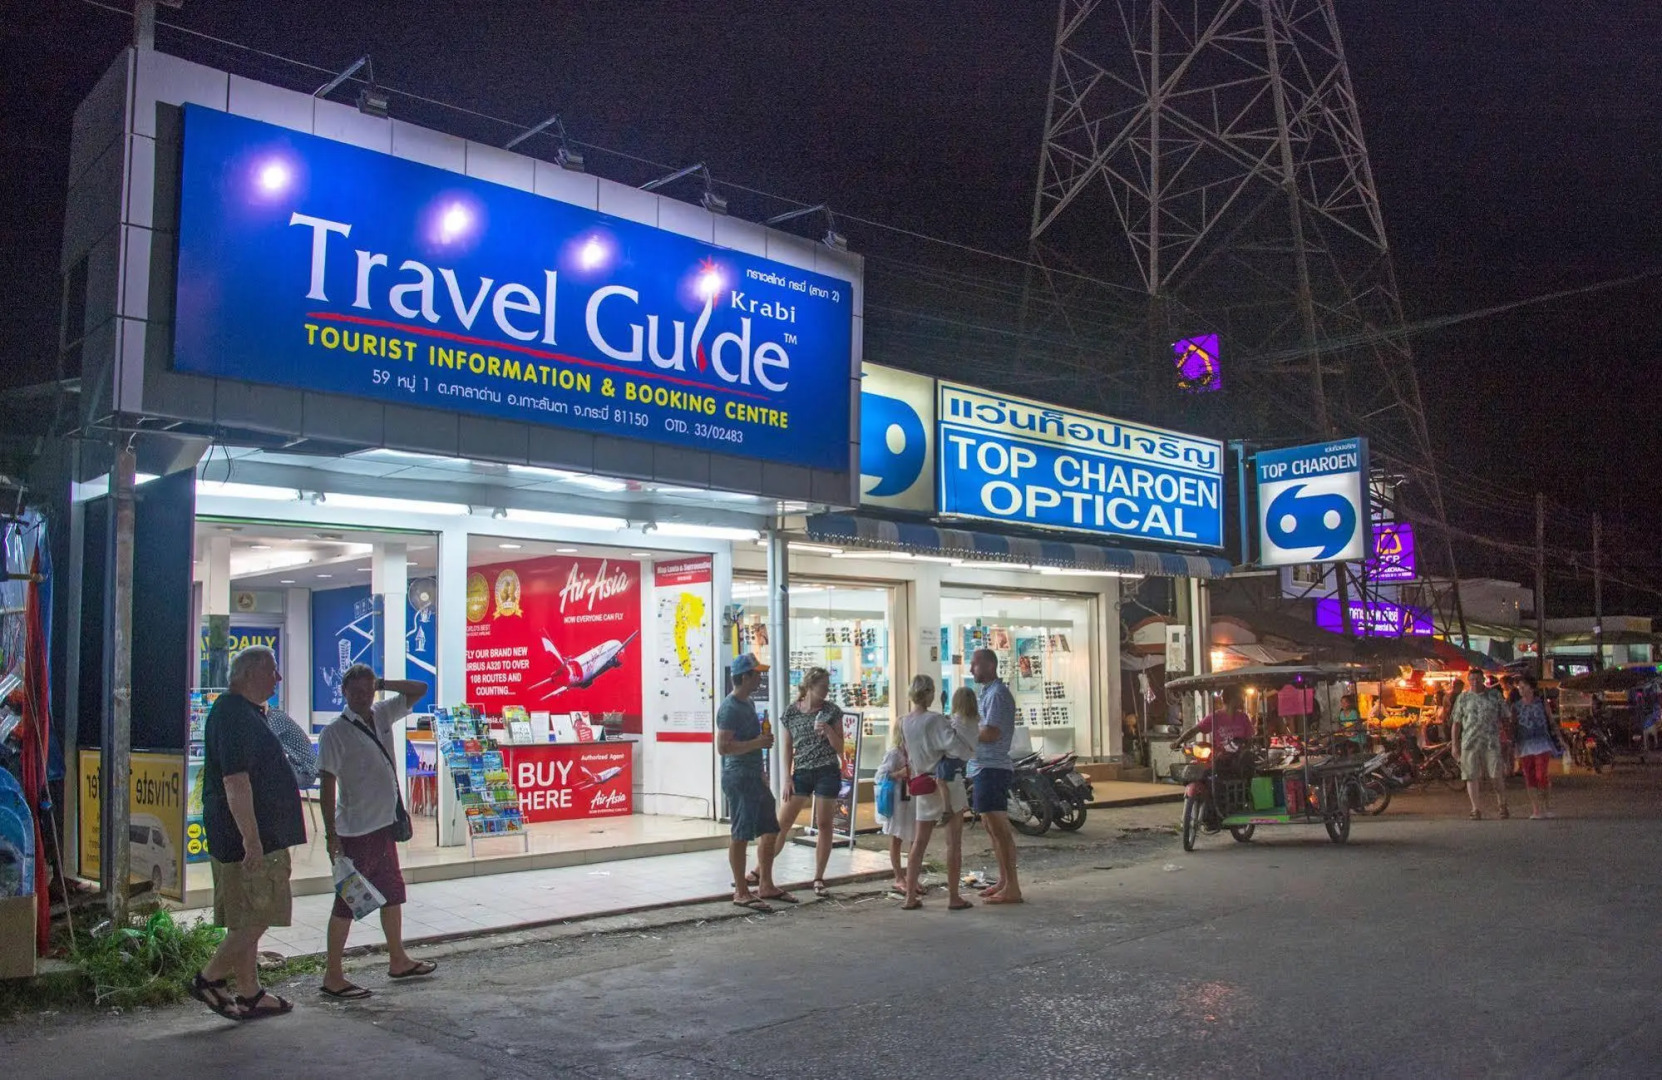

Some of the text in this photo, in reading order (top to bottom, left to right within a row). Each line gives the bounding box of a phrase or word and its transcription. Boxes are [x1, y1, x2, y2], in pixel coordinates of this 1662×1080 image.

[289, 211, 558, 347] Travel
[585, 284, 790, 392] Guide
[731, 290, 796, 323] Krabi
[831, 290, 840, 303] 2)
[304, 323, 789, 429] TOURIST INFORMATION & BOOKING CENTRE
[372, 369, 744, 443] 59 หมู่ 1 ต.ศาลาด่าน อ.เกาะลันตา จ.กระบี่ 81150 OTD. 33/02483
[950, 397, 1216, 470] แว่นท็อปเจริญ
[949, 435, 1218, 510] TOP CHAROEN
[1261, 452, 1357, 480] TOP CHAROEN
[980, 480, 1198, 539] OPTICAL
[559, 558, 629, 614] Air Asia
[563, 612, 624, 624] NOW EVERYONE CAN FLY
[475, 649, 489, 659] OUR
[489, 647, 512, 657] BRAND
[513, 646, 528, 656] NEW
[502, 660, 511, 669] TO
[511, 659, 530, 669] OVER
[482, 674, 508, 683] ROUTES
[508, 672, 522, 682] AND
[518, 760, 574, 788] BUY
[518, 788, 573, 811] HERE
[590, 789, 627, 810] Air Asia
